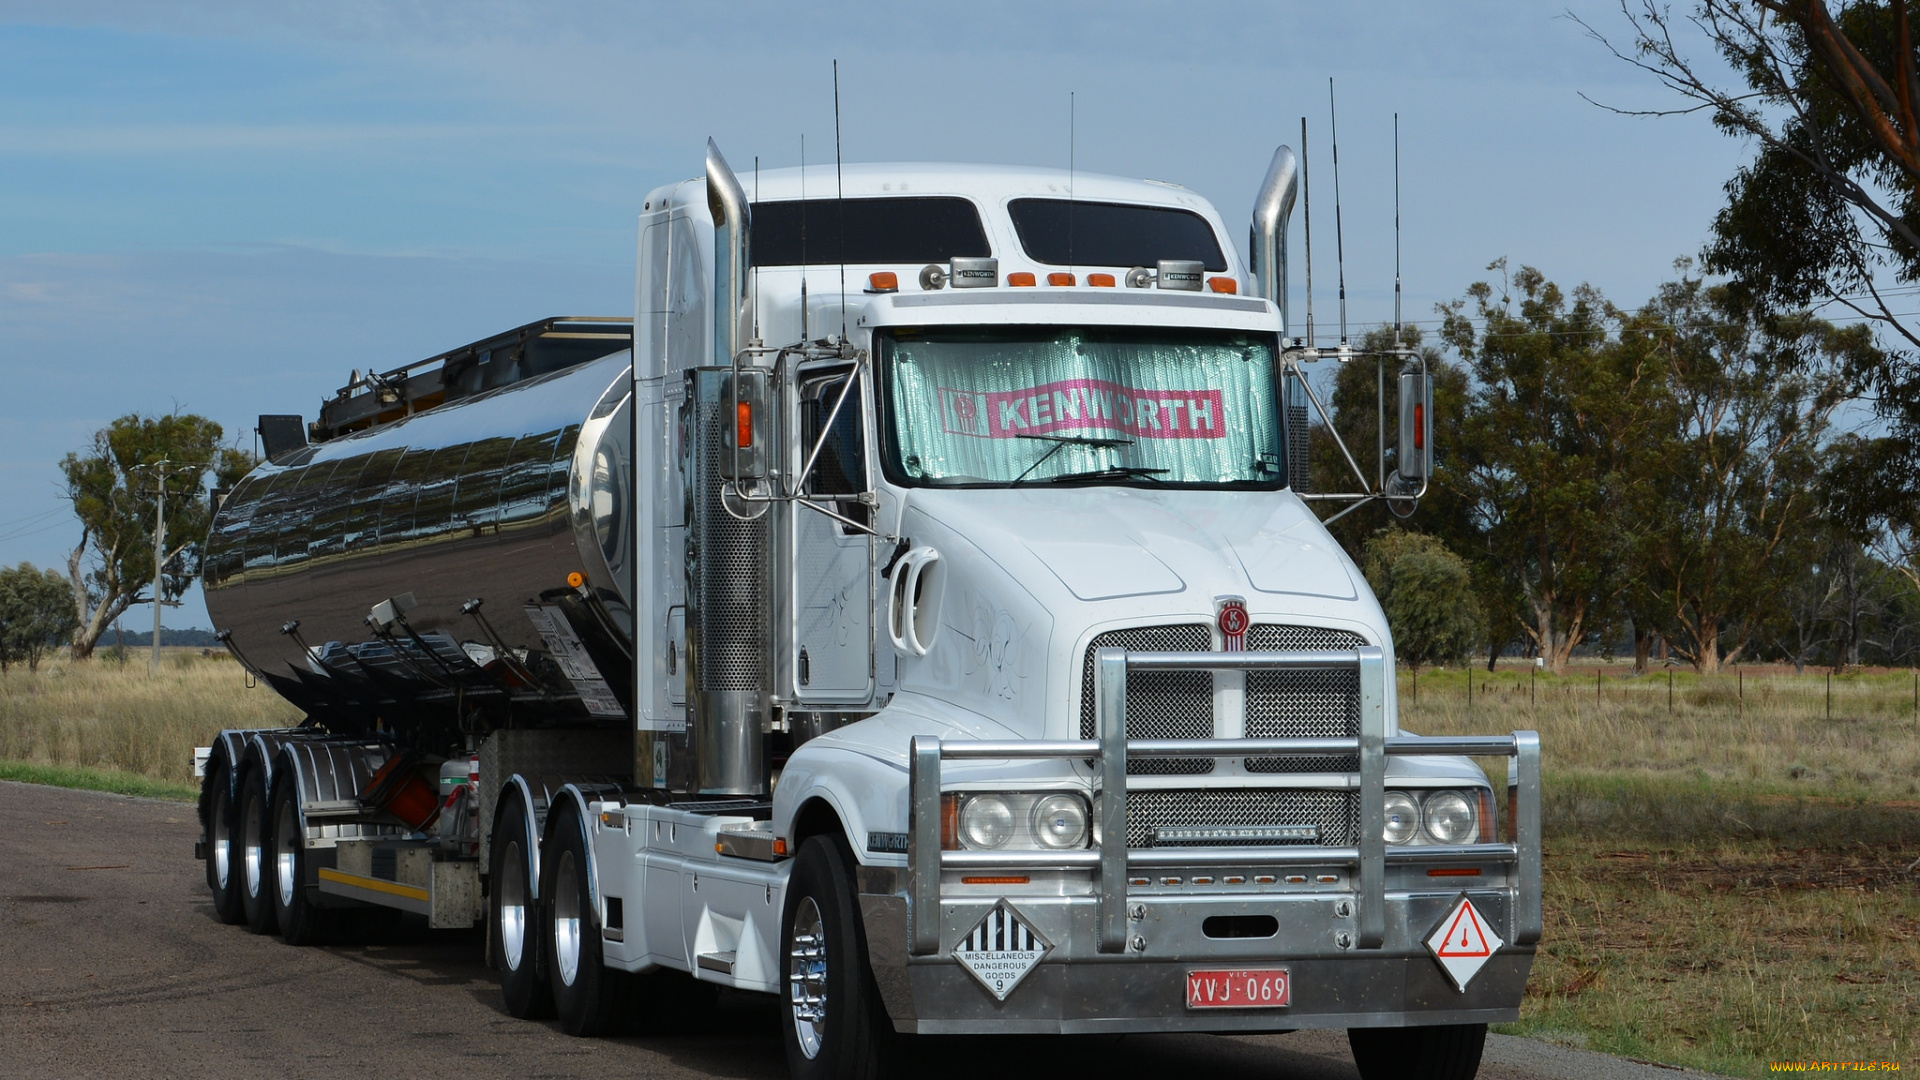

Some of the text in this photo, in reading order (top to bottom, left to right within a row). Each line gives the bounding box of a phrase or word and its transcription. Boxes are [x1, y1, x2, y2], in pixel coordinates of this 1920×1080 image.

[998, 387, 1215, 431] KENWORTH
[1230, 611, 1238, 621] K
[1227, 621, 1240, 630] W
[965, 952, 1035, 960] MISCELLANEOUS
[974, 962, 1027, 970] DANGEROUS
[996, 980, 1004, 991] 9
